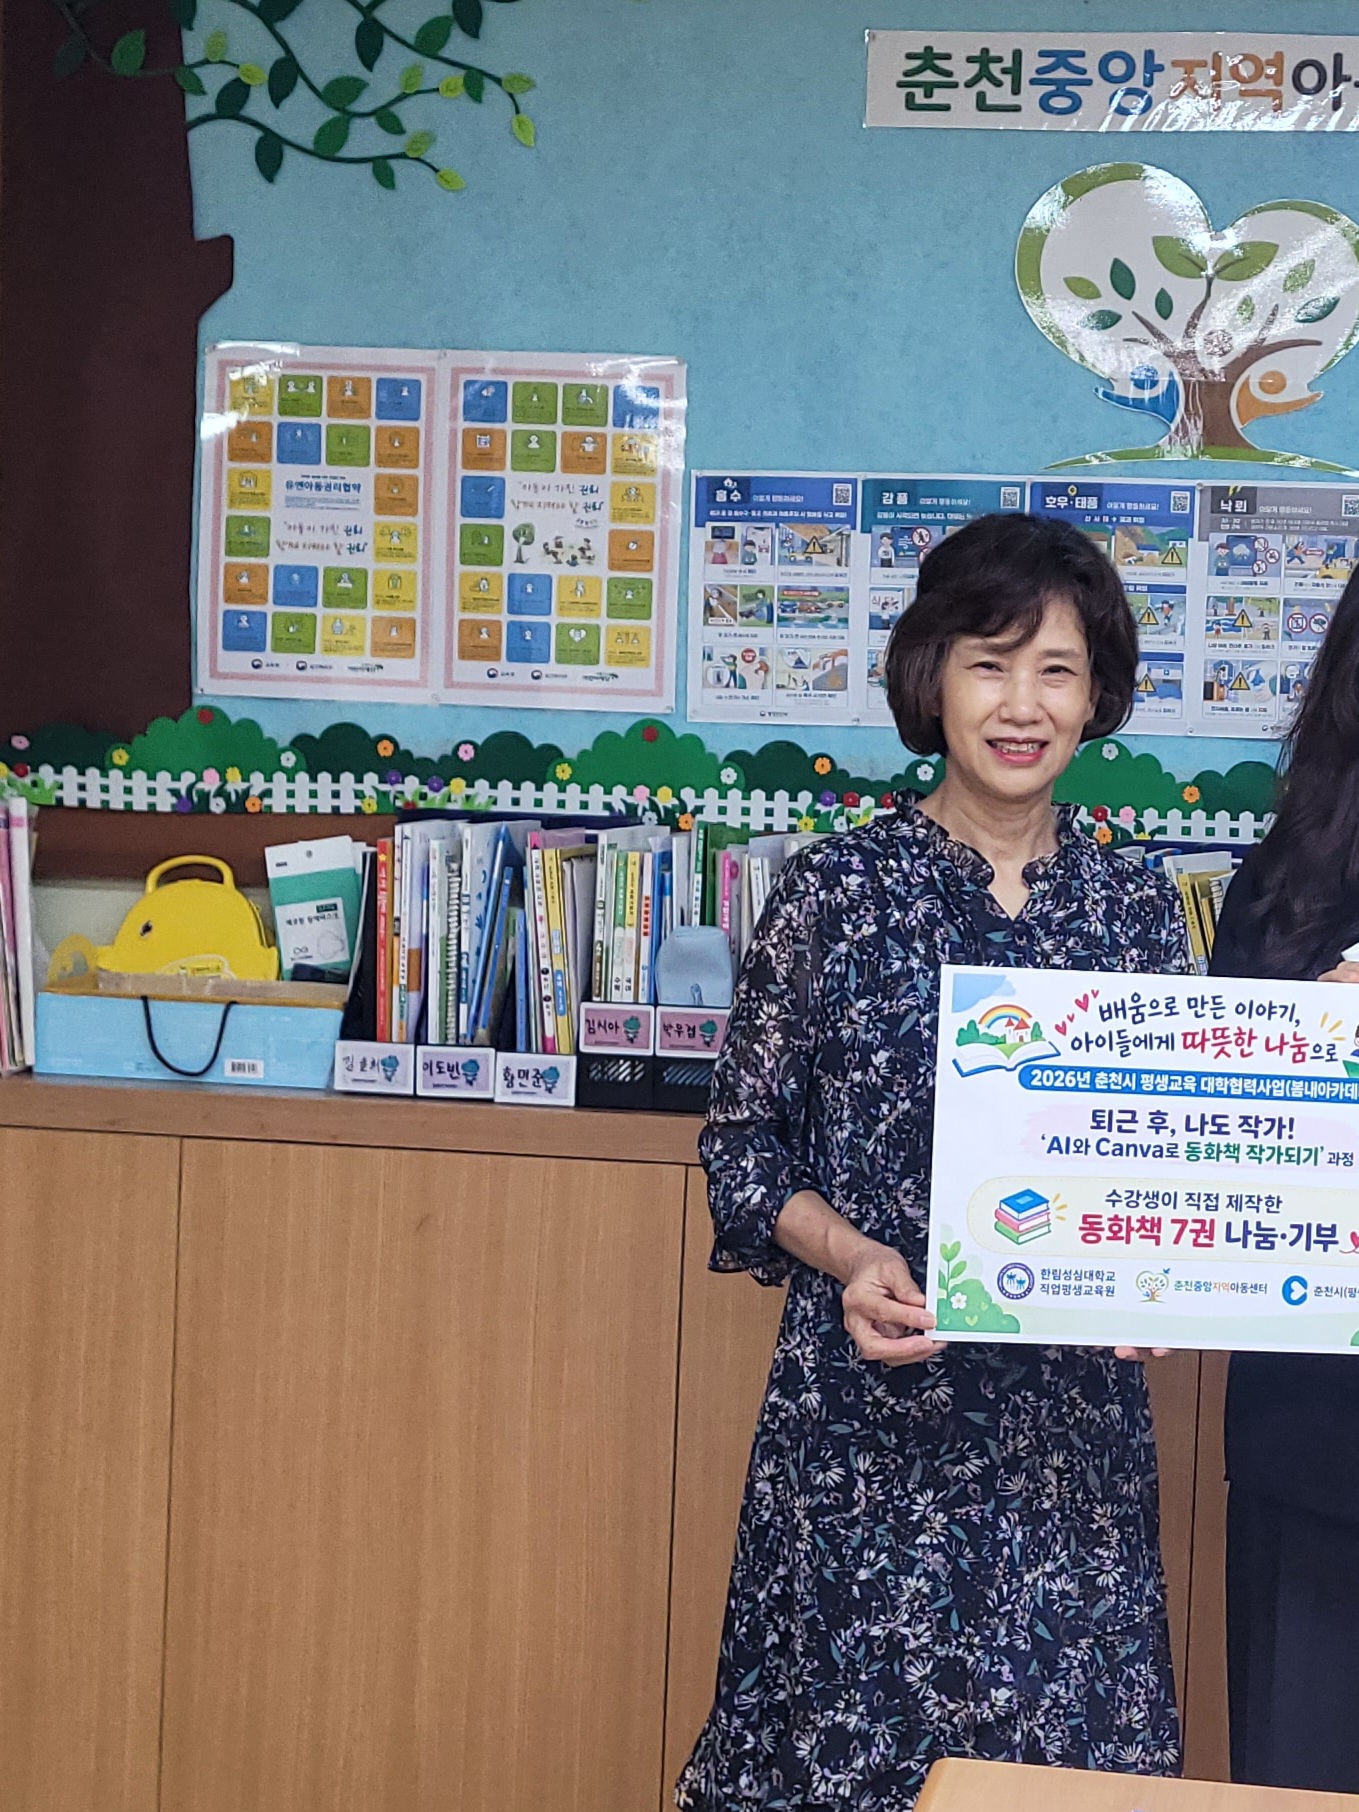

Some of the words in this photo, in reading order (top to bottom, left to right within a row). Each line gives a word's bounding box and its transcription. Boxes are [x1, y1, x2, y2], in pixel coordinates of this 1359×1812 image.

[1045, 496, 1099, 509] 호우·태풍
[1219, 499, 1247, 513] 낙뢰
[1098, 991, 1179, 1023] 배움으로
[1186, 994, 1227, 1021] 만든
[1235, 999, 1301, 1026] 이야기,
[585, 1018, 620, 1035] 김시아
[1070, 1029, 1176, 1056] 아이들에게
[1181, 1025, 1259, 1061] 따뜻한
[1264, 1031, 1339, 1064] 나눔으로
[423, 1060, 460, 1080] 이도빈
[502, 1066, 543, 1089] 황민준
[1030, 1068, 1092, 1089] 2026년
[1094, 1070, 1137, 1091] 춘천시
[1140, 1071, 1198, 1094] 평생교육
[1089, 1108, 1139, 1134] 퇴근
[1146, 1109, 1176, 1137] 후,
[1184, 1112, 1231, 1137] 나도
[1237, 1114, 1295, 1140] 작가!
[1095, 1137, 1180, 1160] Canva로
[1184, 1141, 1241, 1163] 동화책
[1326, 1151, 1354, 1167] 과정
[1104, 1188, 1178, 1211] 수강생이
[1184, 1191, 1220, 1212] 직접
[1225, 1193, 1283, 1215] 제작한
[1078, 1213, 1162, 1246] 동화책
[1170, 1217, 1216, 1248] 7권
[1225, 1220, 1339, 1253] 나눔·기부
[1040, 1267, 1116, 1283] 한림성심대학교
[1039, 1282, 1116, 1298] 직업평생교육원
[1173, 1280, 1268, 1295] 춘천중앙지역아동센터
